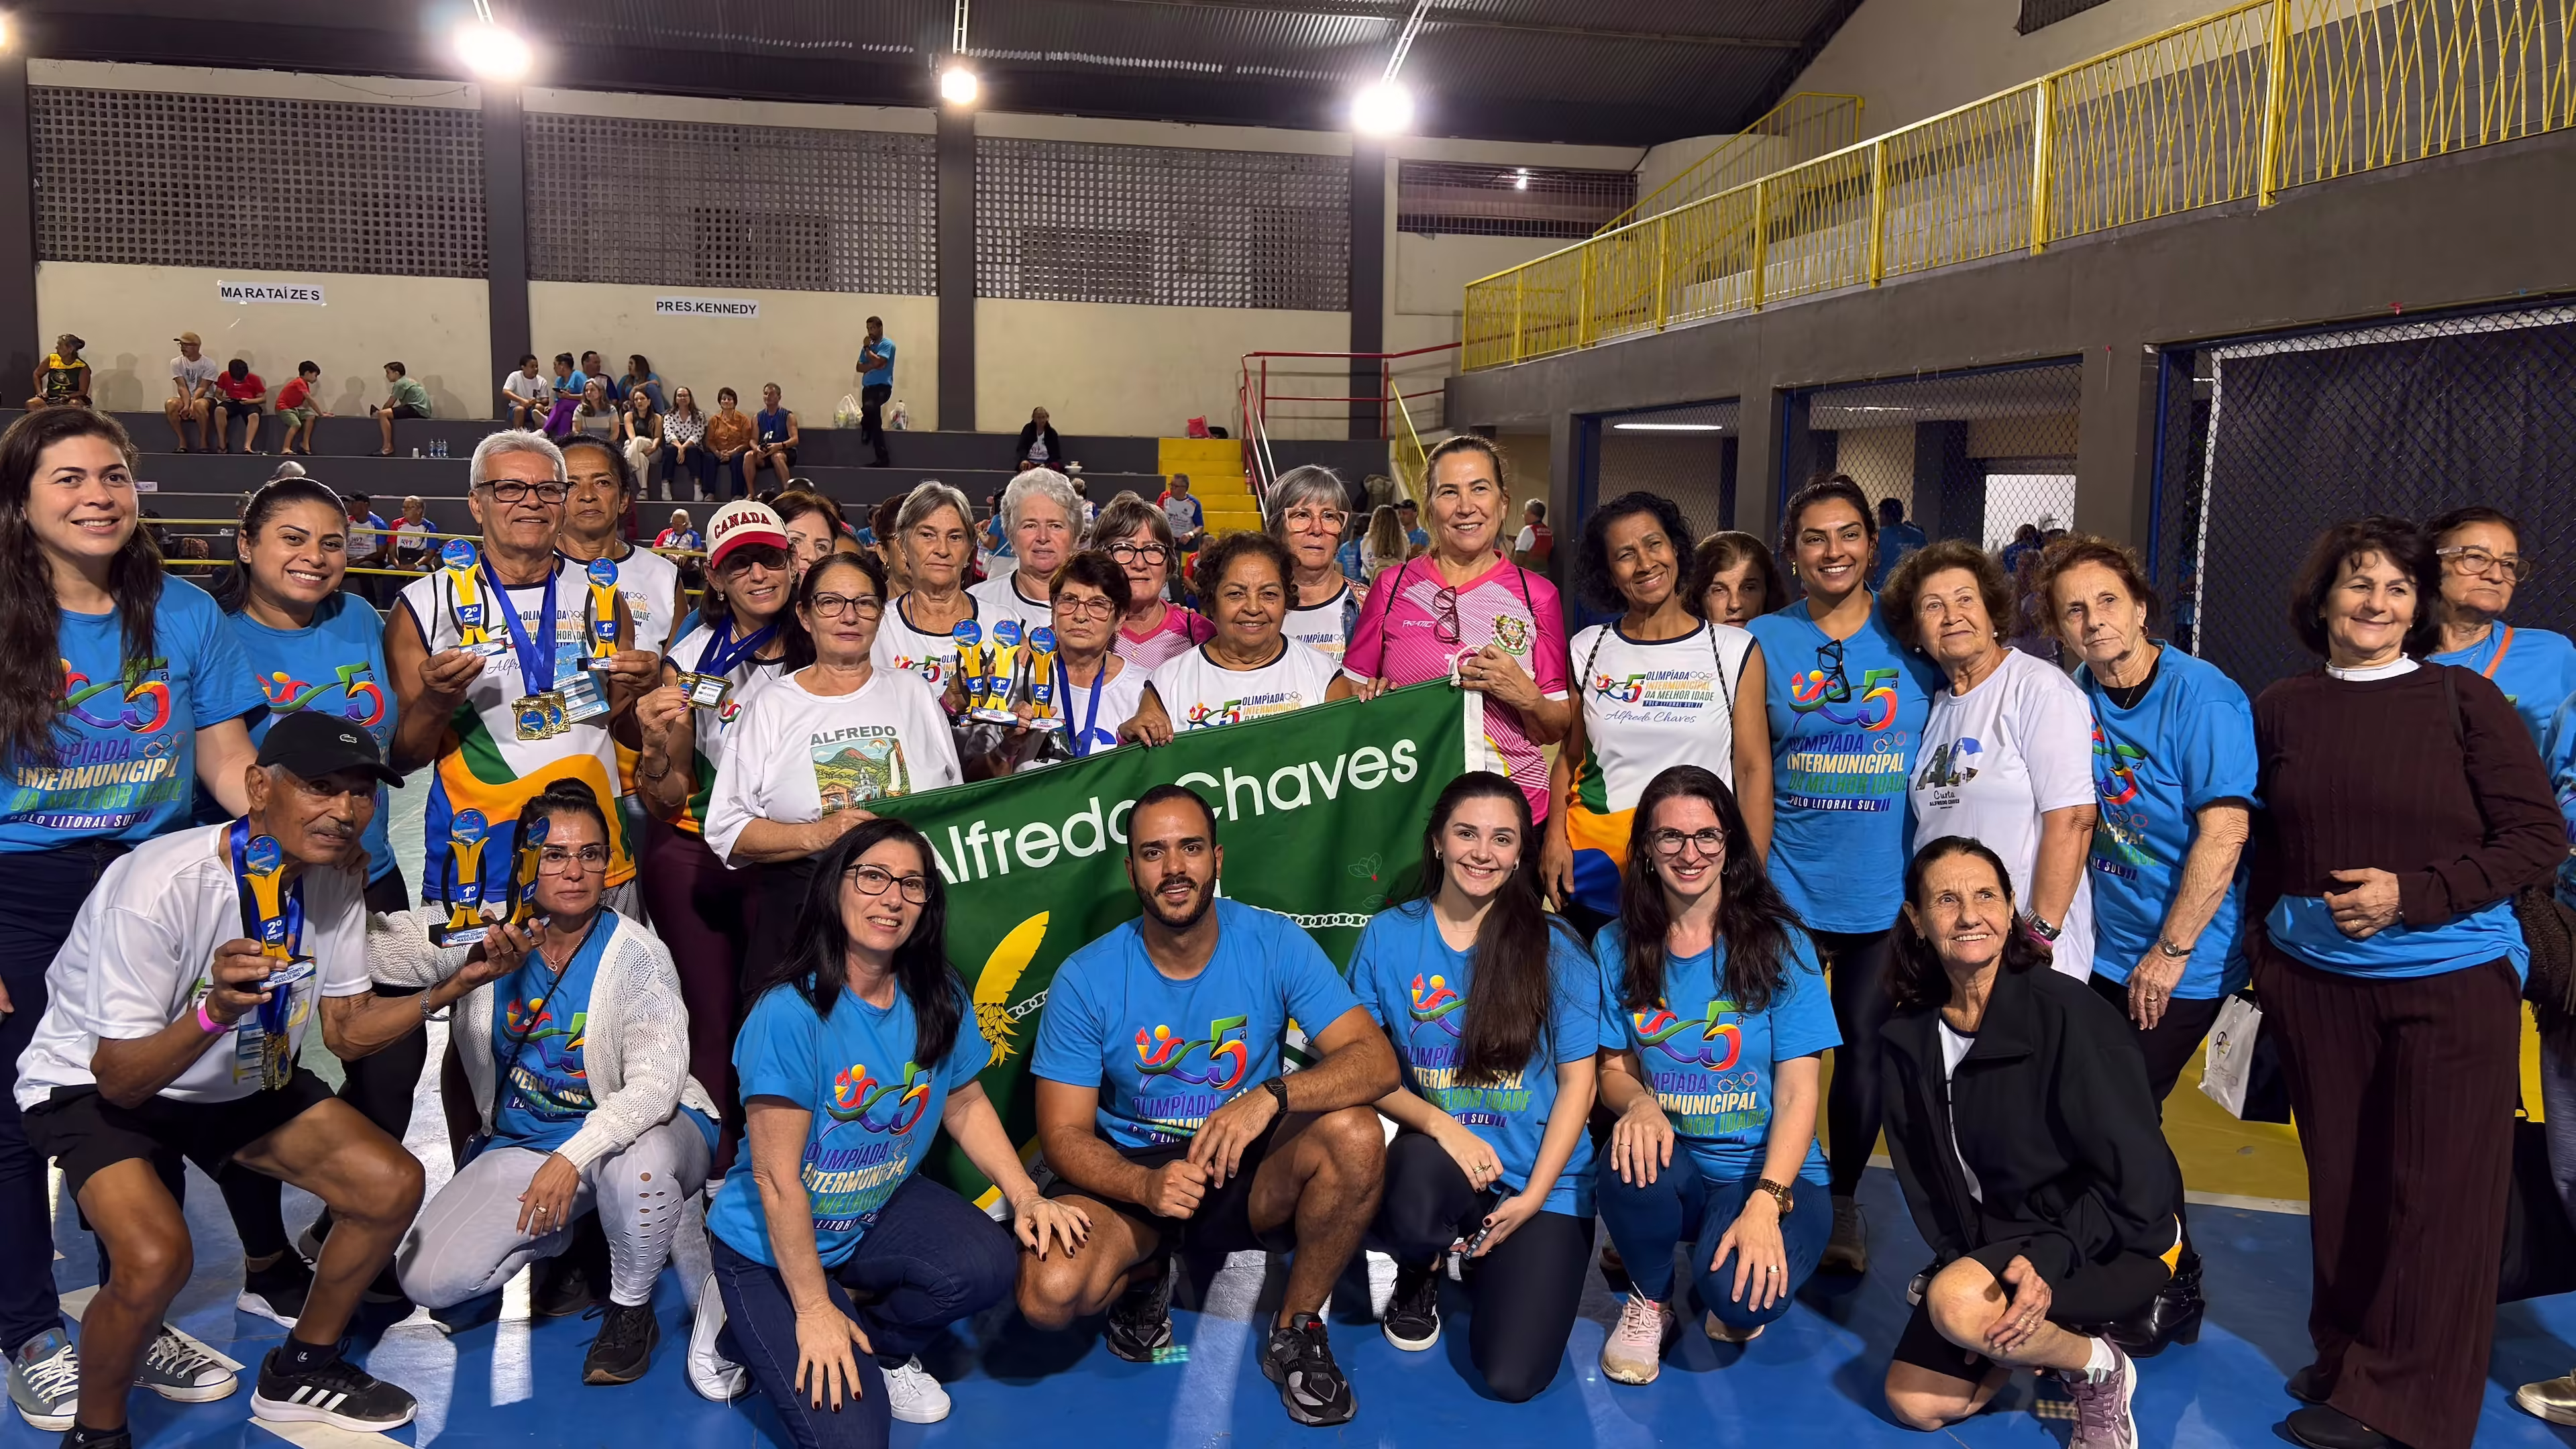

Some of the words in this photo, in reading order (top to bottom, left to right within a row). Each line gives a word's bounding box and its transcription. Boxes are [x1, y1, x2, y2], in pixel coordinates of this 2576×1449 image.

[714, 512, 771, 539] CANADA
[464, 606, 478, 618] 2º
[602, 623, 612, 632] 1º
[486, 659, 521, 675] Alfr
[1646, 669, 1690, 680] OLIMPÍADA
[996, 679, 1006, 688] 1º
[1646, 680, 1710, 691] INTERMUNICIPAL
[1036, 686, 1049, 696] 2º
[1644, 690, 1655, 699] DA
[1658, 691, 1689, 700] MELHOR
[1690, 692, 1715, 701] IDADE
[1242, 692, 1285, 706] OLIMPÍADA
[1604, 710, 1651, 724] Alfredo
[1654, 712, 1697, 723] Chaves
[810, 726, 896, 746] ALFREDO
[1789, 731, 1864, 753] OLIMPÍADA
[1787, 752, 1904, 773] INTERMUNICIPAL
[1788, 772, 1803, 790] DA
[1805, 773, 1868, 794] MELHOR
[10, 788, 40, 811] DA
[1812, 798, 1852, 810] LITORAL
[1858, 800, 1876, 811] SUL
[50, 814, 108, 828] LITORAL
[463, 885, 476, 898] 1º
[267, 919, 282, 935] 2º
[266, 931, 284, 941] Lugar
[274, 972, 301, 984] MASCULINO
[1132, 1091, 1217, 1119] OLIMPÍADA
[1470, 1113, 1489, 1124] SUL
[1719, 1108, 1768, 1134] IDADE
